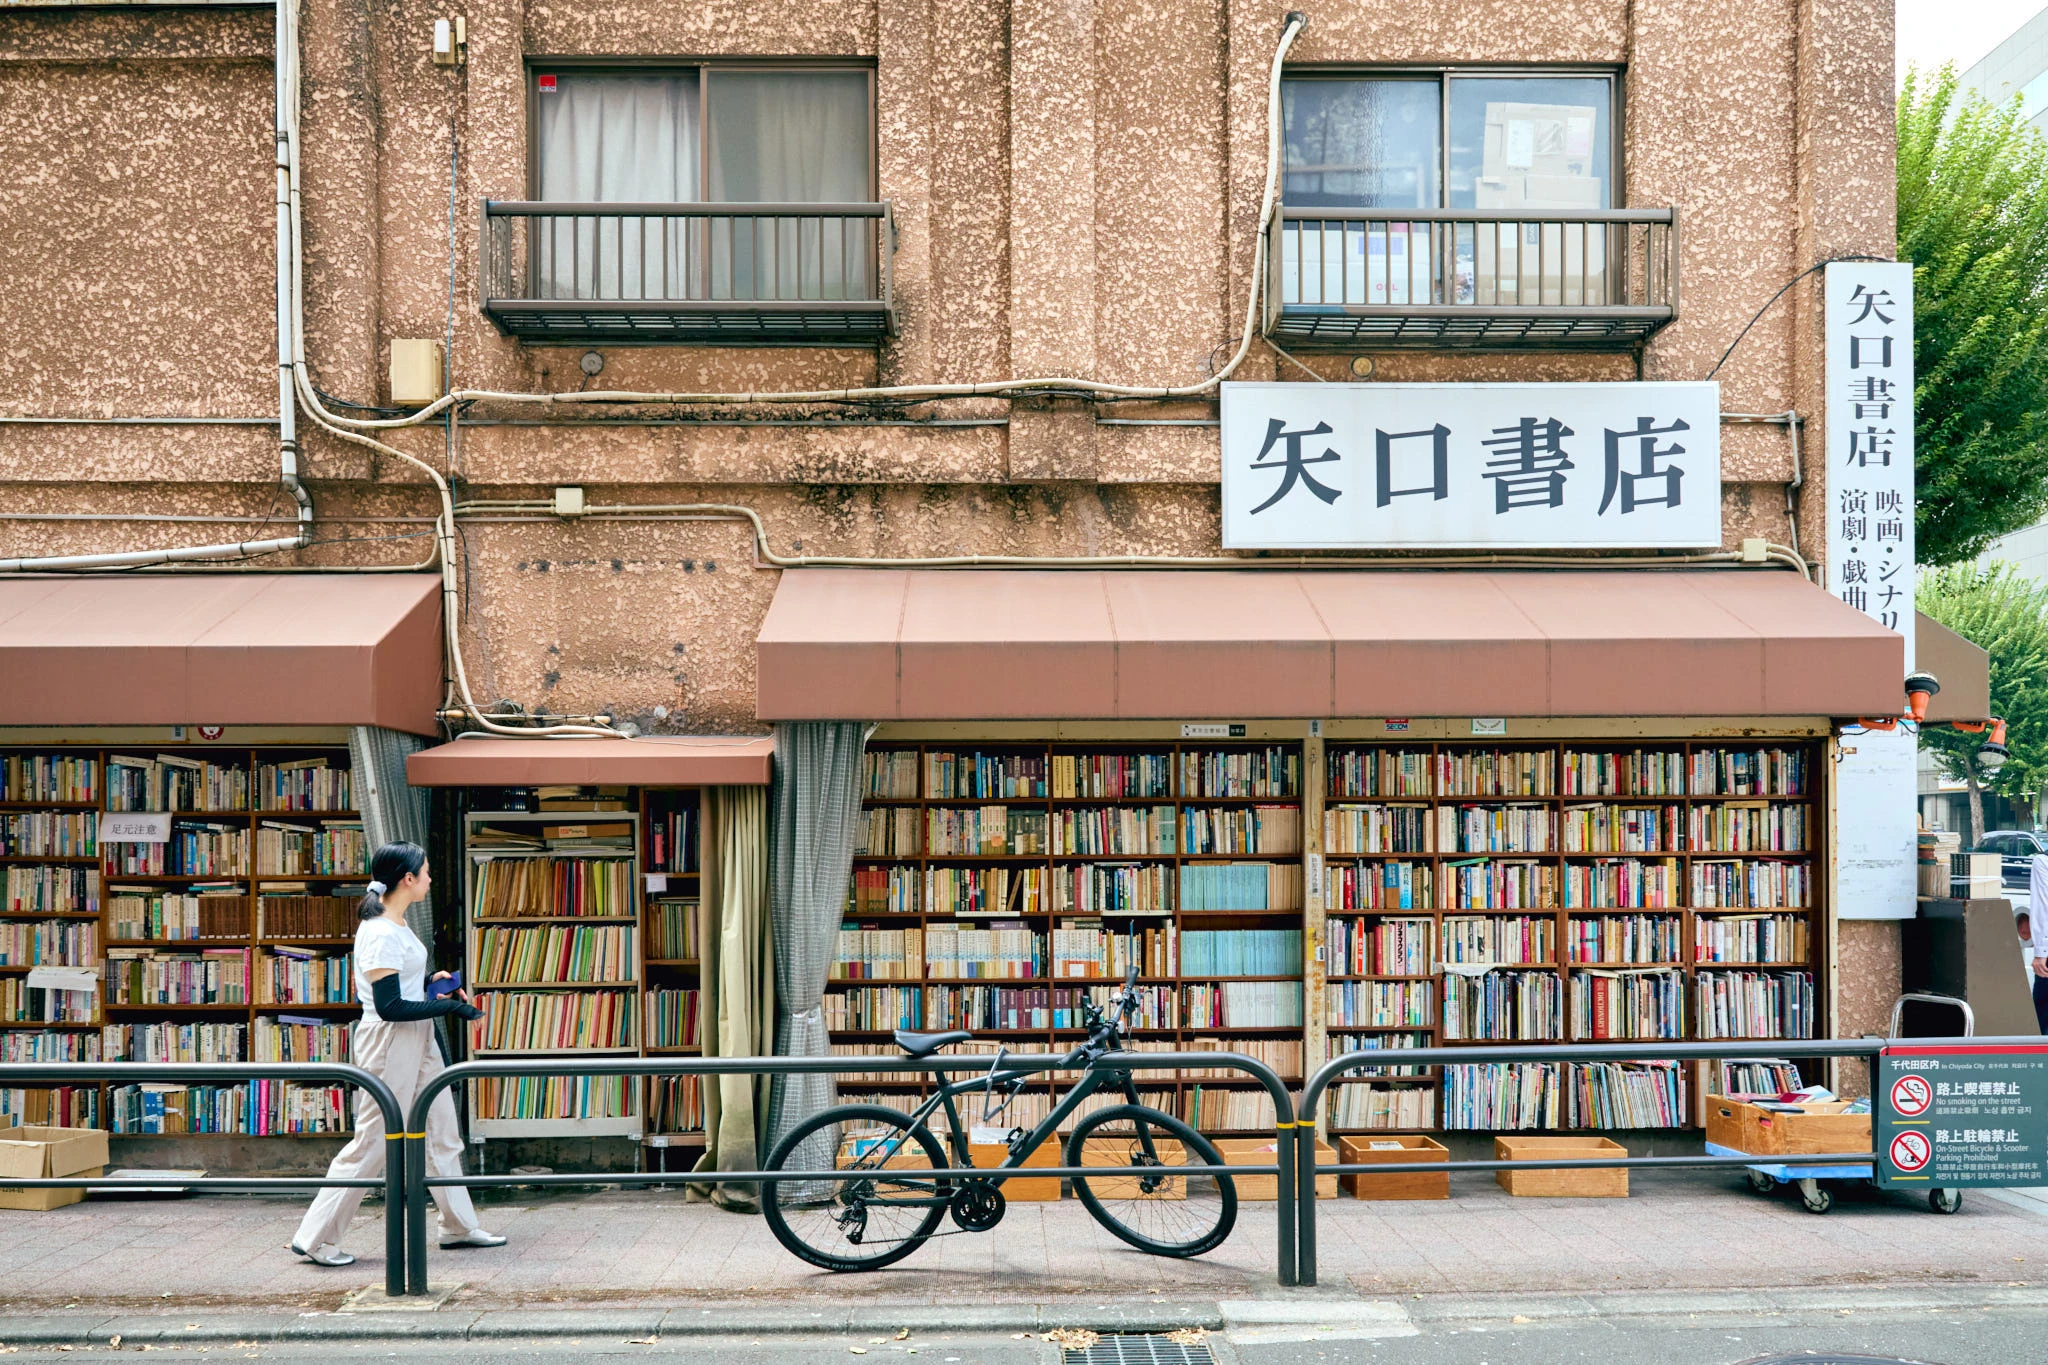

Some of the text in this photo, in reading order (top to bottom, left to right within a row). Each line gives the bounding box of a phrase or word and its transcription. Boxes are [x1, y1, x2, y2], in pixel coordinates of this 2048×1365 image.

[1846, 284, 1897, 468] 矢口書店
[1249, 416, 1691, 517] 矢口書店
[1840, 489, 1868, 613] 演劇・戯曲
[111, 823, 158, 835] 足元注意
[1891, 1060, 1940, 1071] 千代田区内
[1948, 1063, 1973, 1071] Chiyoda
[1973, 1063, 1986, 1071] City
[1936, 1081, 2020, 1096] 路上喫煙禁止
[1947, 1097, 1977, 1106] smoking
[1988, 1097, 2000, 1105] the
[2000, 1097, 2021, 1105] street
[1935, 1128, 2019, 1143] 路上駐輪禁止
[1935, 1144, 1969, 1153] On-Street
[1970, 1144, 1994, 1154] Bicycle
[2002, 1144, 2029, 1152] Scooter
[1935, 1153, 1999, 1162] Parking Prohibited
